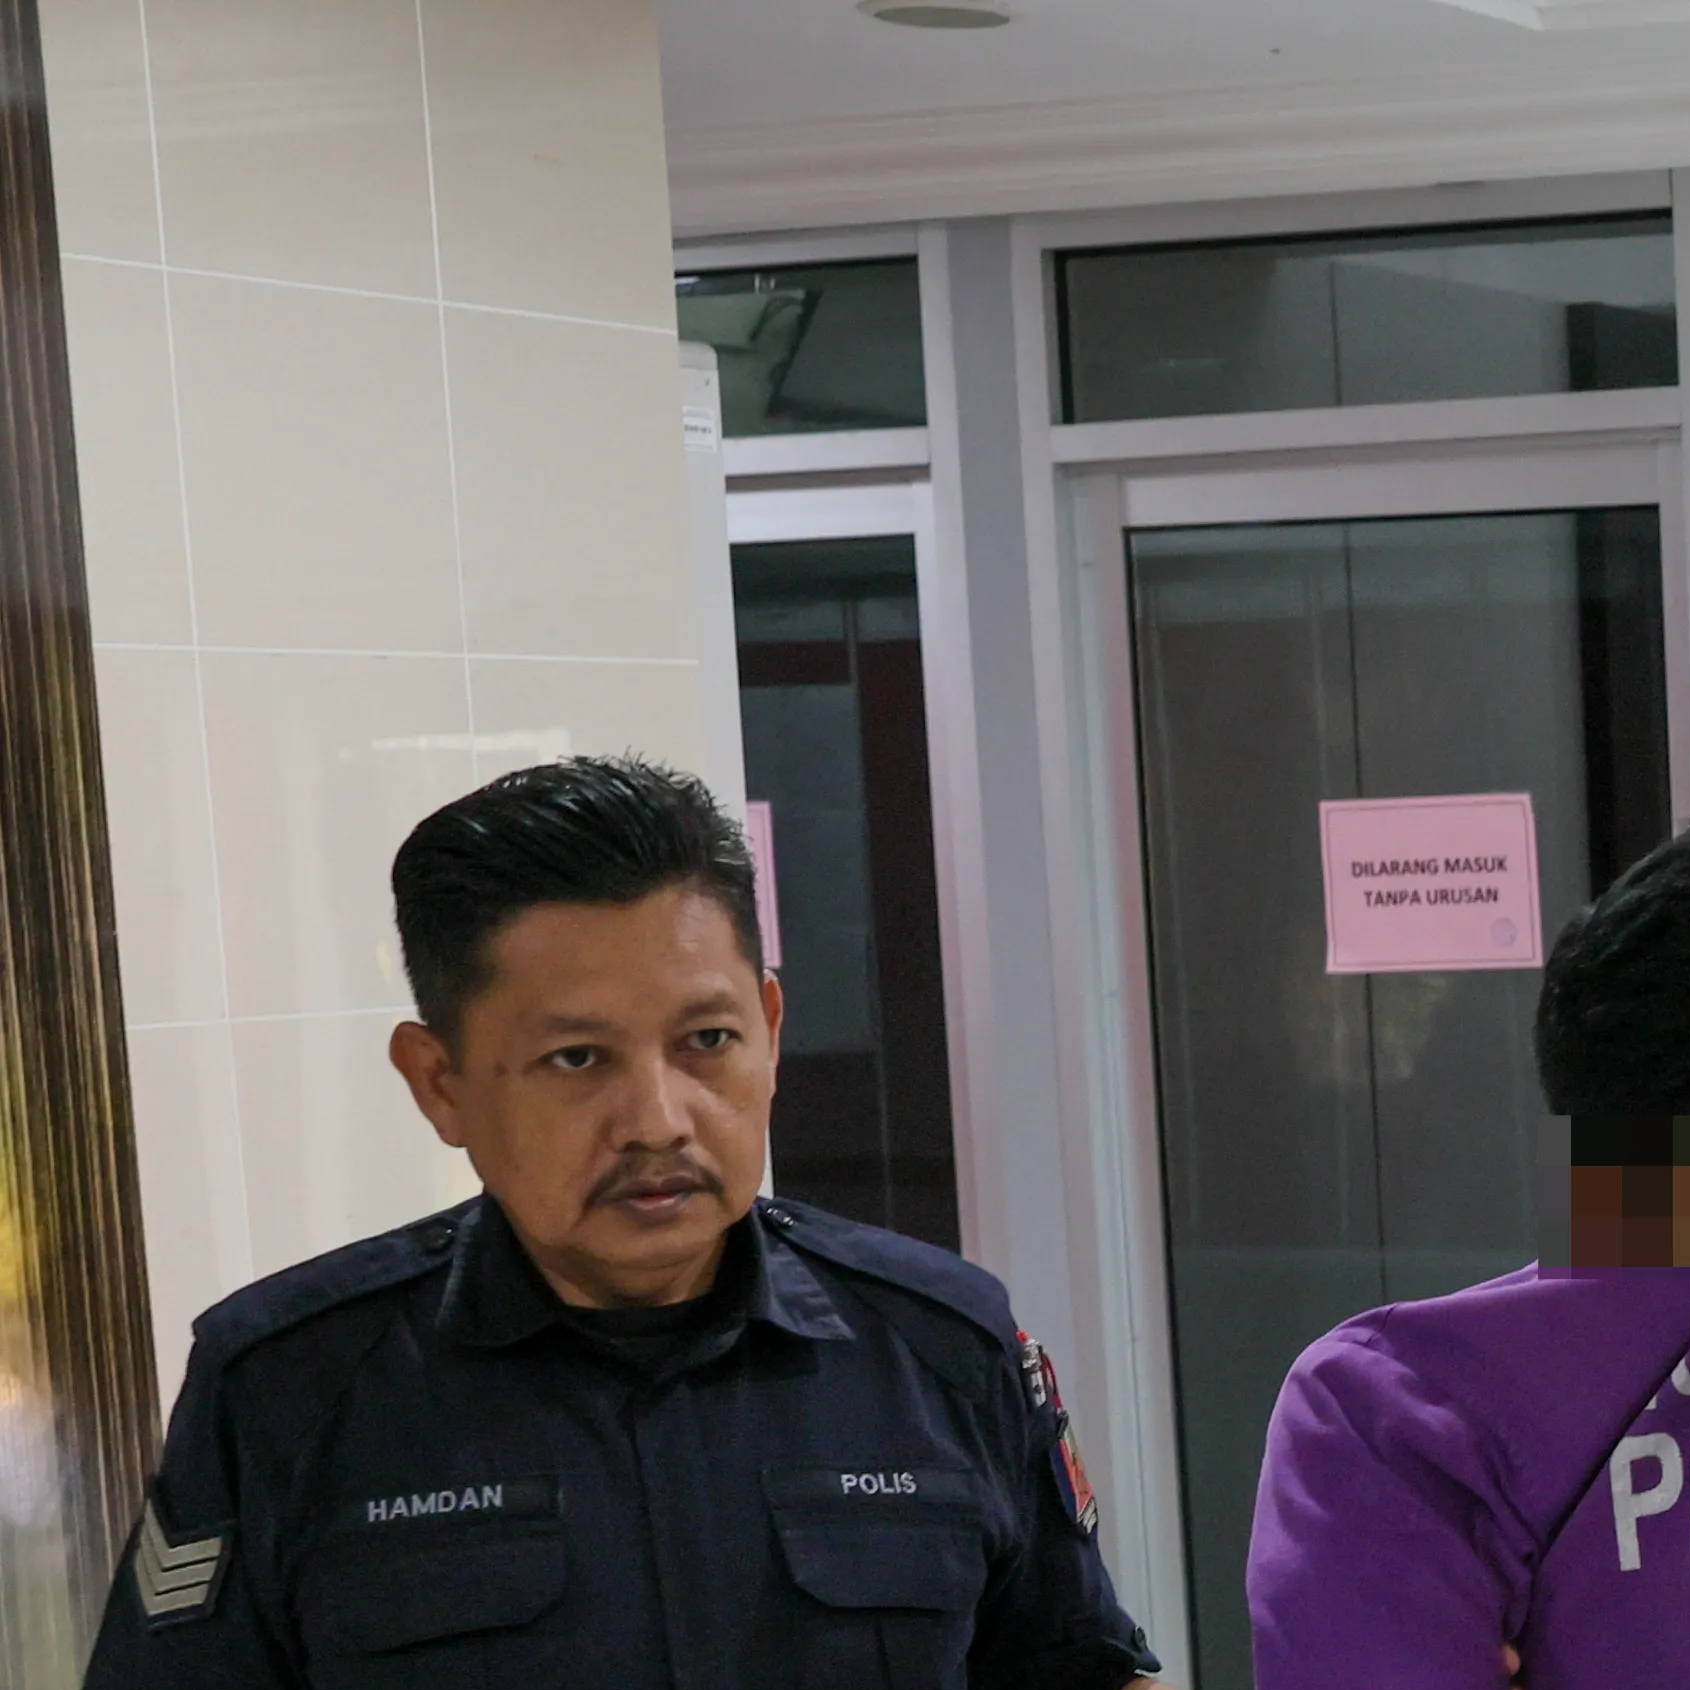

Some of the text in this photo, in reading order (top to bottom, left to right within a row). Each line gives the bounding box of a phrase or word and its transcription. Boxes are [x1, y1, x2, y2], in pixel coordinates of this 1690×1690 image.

[1351, 856, 1508, 877] DILARANG MASUK
[1364, 887, 1499, 907] TANPA URUSAN
[840, 1471, 917, 1496] POLIS
[367, 1483, 503, 1524] HAMDAN
